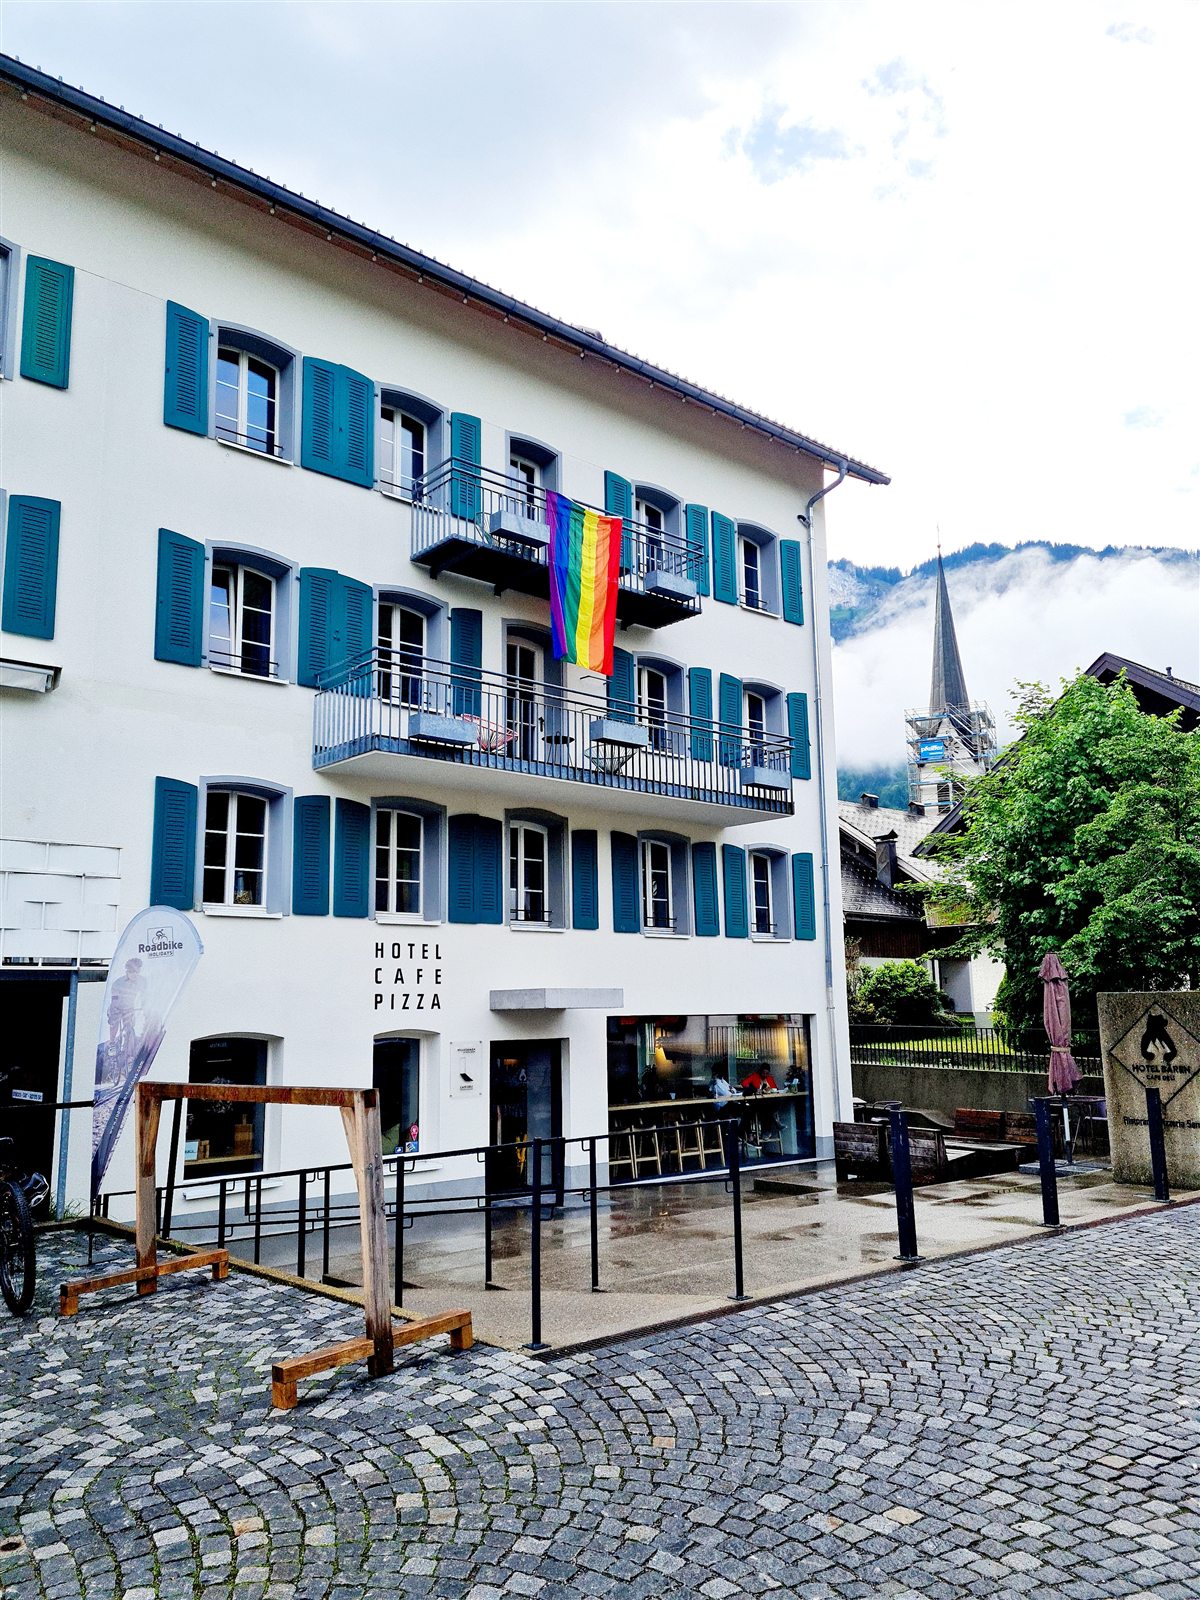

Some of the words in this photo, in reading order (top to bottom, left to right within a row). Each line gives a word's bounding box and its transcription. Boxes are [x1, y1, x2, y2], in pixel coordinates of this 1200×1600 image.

[138, 941, 183, 953] Roadbike
[375, 942, 442, 959] HOTEL
[375, 967, 442, 985] CAFE
[374, 993, 441, 1010] PIZZA
[1132, 1065, 1160, 1073] HOTEL
[1161, 1064, 1190, 1073] BÄREN
